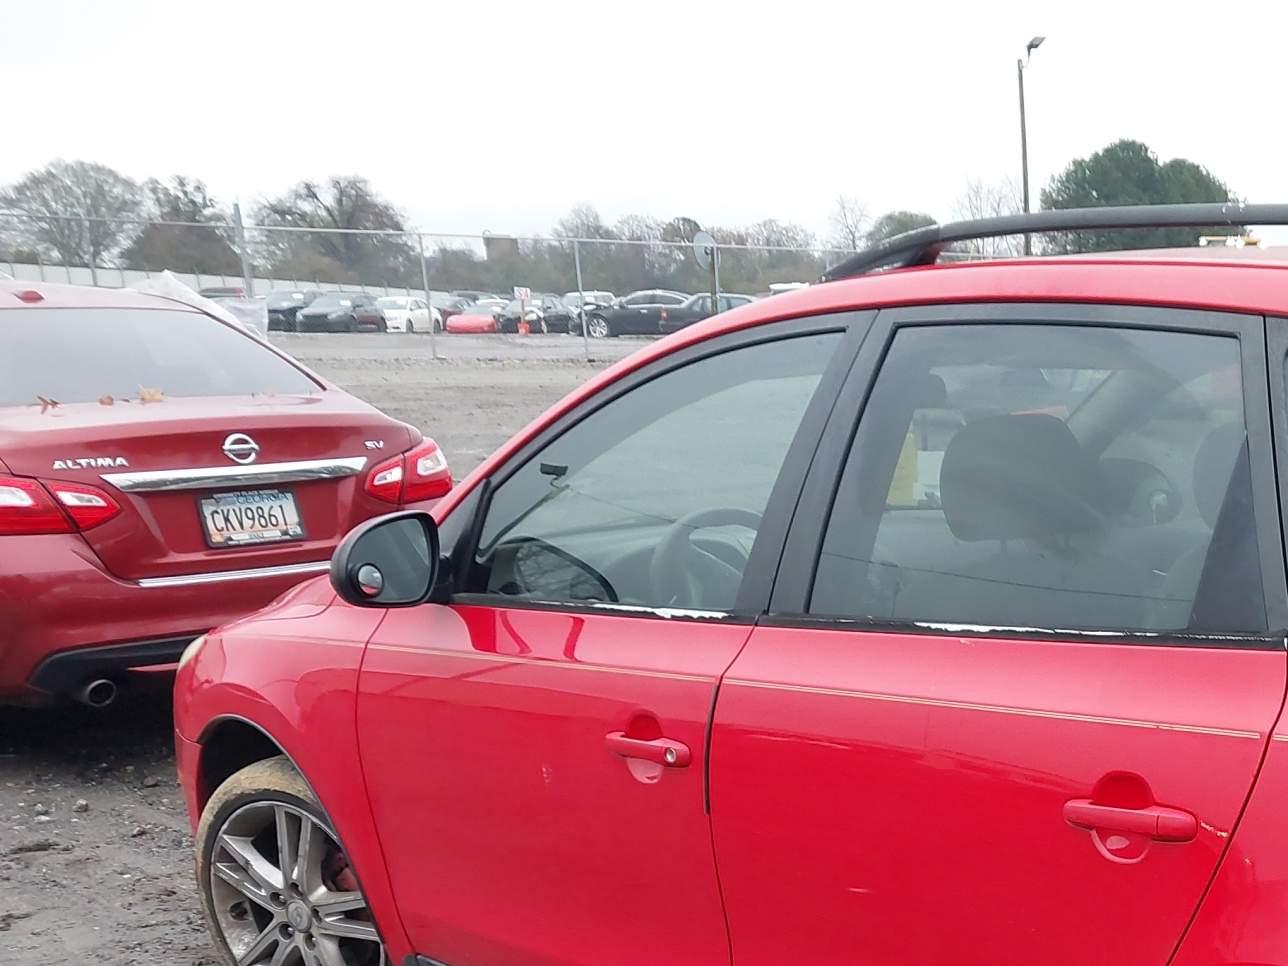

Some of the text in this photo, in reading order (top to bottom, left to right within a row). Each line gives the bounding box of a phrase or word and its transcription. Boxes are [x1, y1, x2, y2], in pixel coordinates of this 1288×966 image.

[364, 440, 384, 450] SV
[52, 456, 129, 470] ALTIMA
[210, 504, 288, 532] CKV9861
